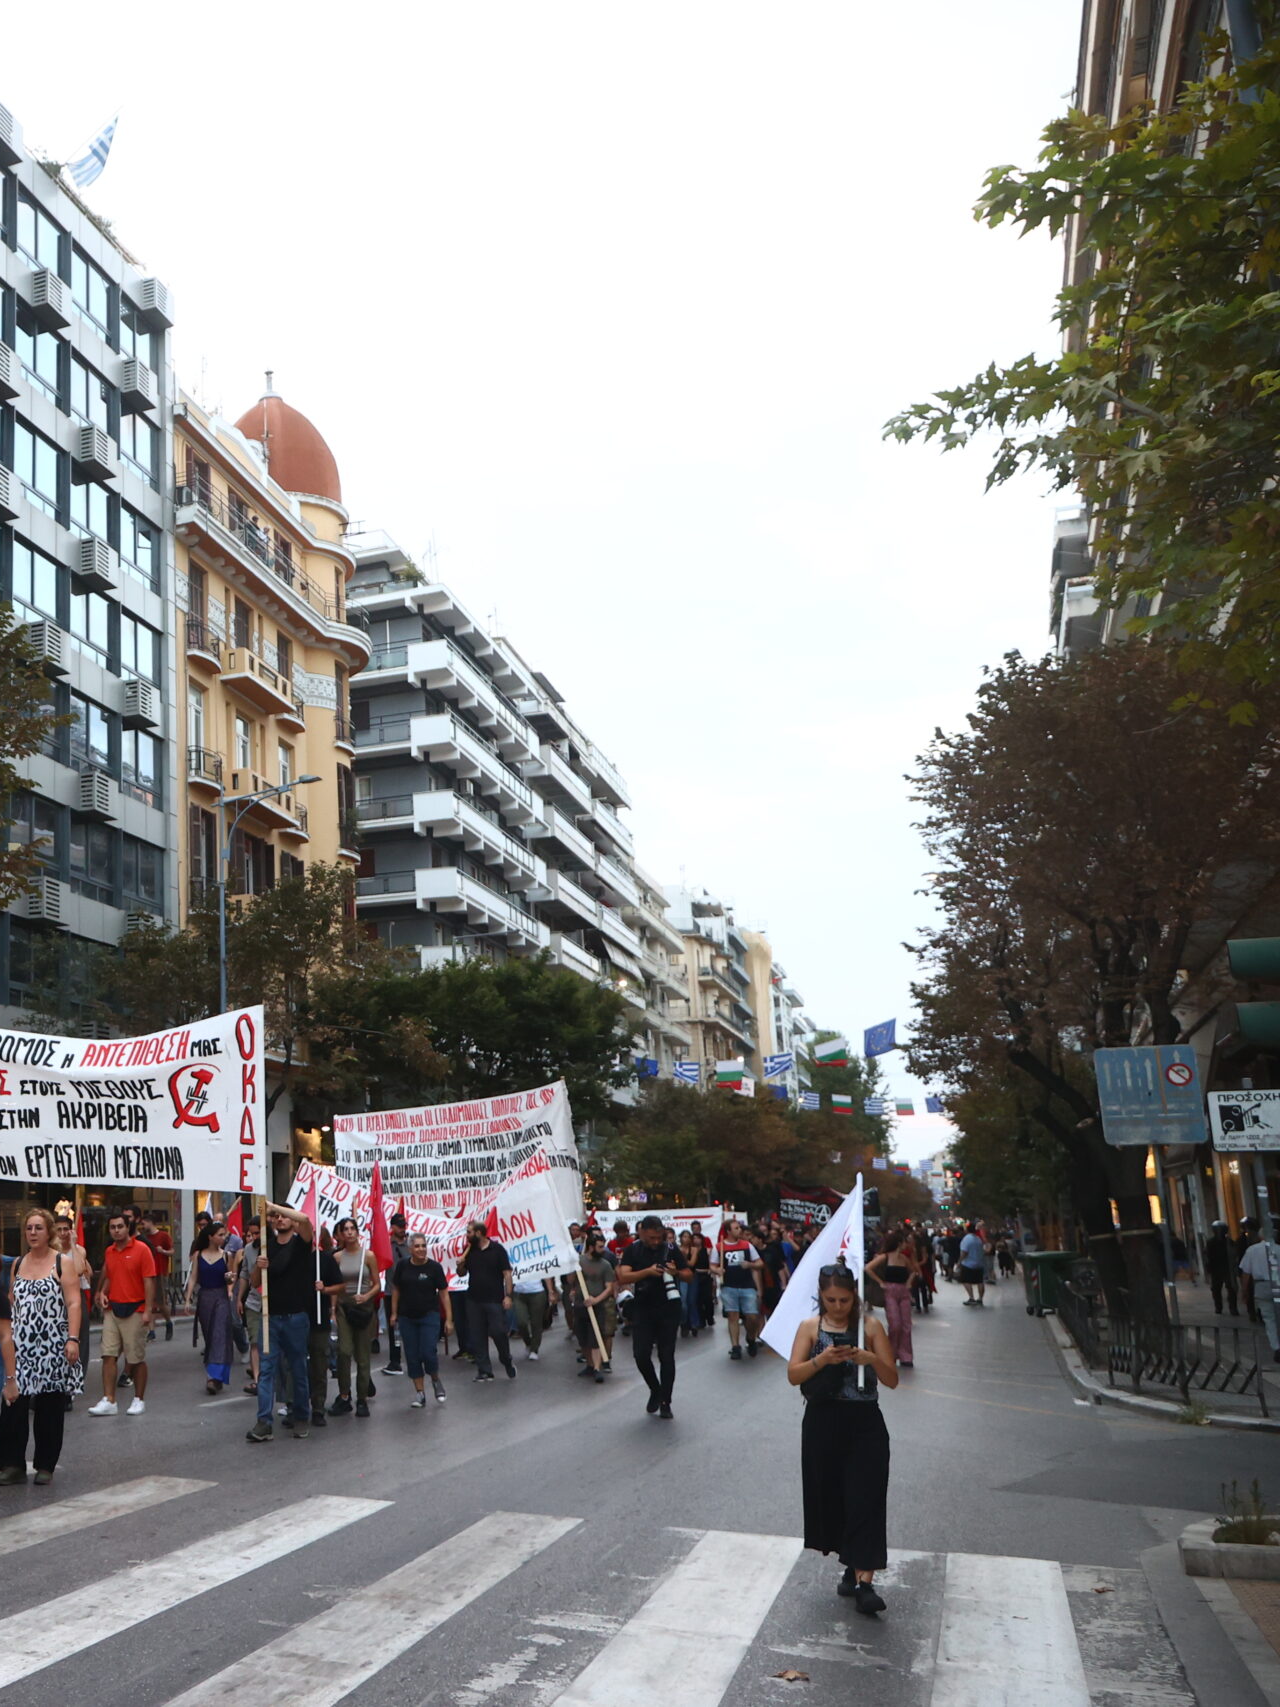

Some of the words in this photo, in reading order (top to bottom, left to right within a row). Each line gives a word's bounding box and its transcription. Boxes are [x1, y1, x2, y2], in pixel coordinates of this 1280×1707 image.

[80, 1030, 191, 1068] ΑΝΤΕΠΙΘΕΣΗ
[191, 1037, 222, 1057] ΜΑΣ
[20, 1079, 66, 1096] ΣΤΟΥΣ
[69, 1078, 164, 1100] ΜΙΣΘΟΥΣ
[56, 1101, 148, 1133] ΑΚΡΙΒΕΙΑ
[25, 1144, 107, 1178] ΕΡΓΑΣΙΑΚΟ
[114, 1145, 185, 1181] ΜΕΣΑΙΩΝΑ
[321, 1173, 350, 1202] ΣΤΟ
